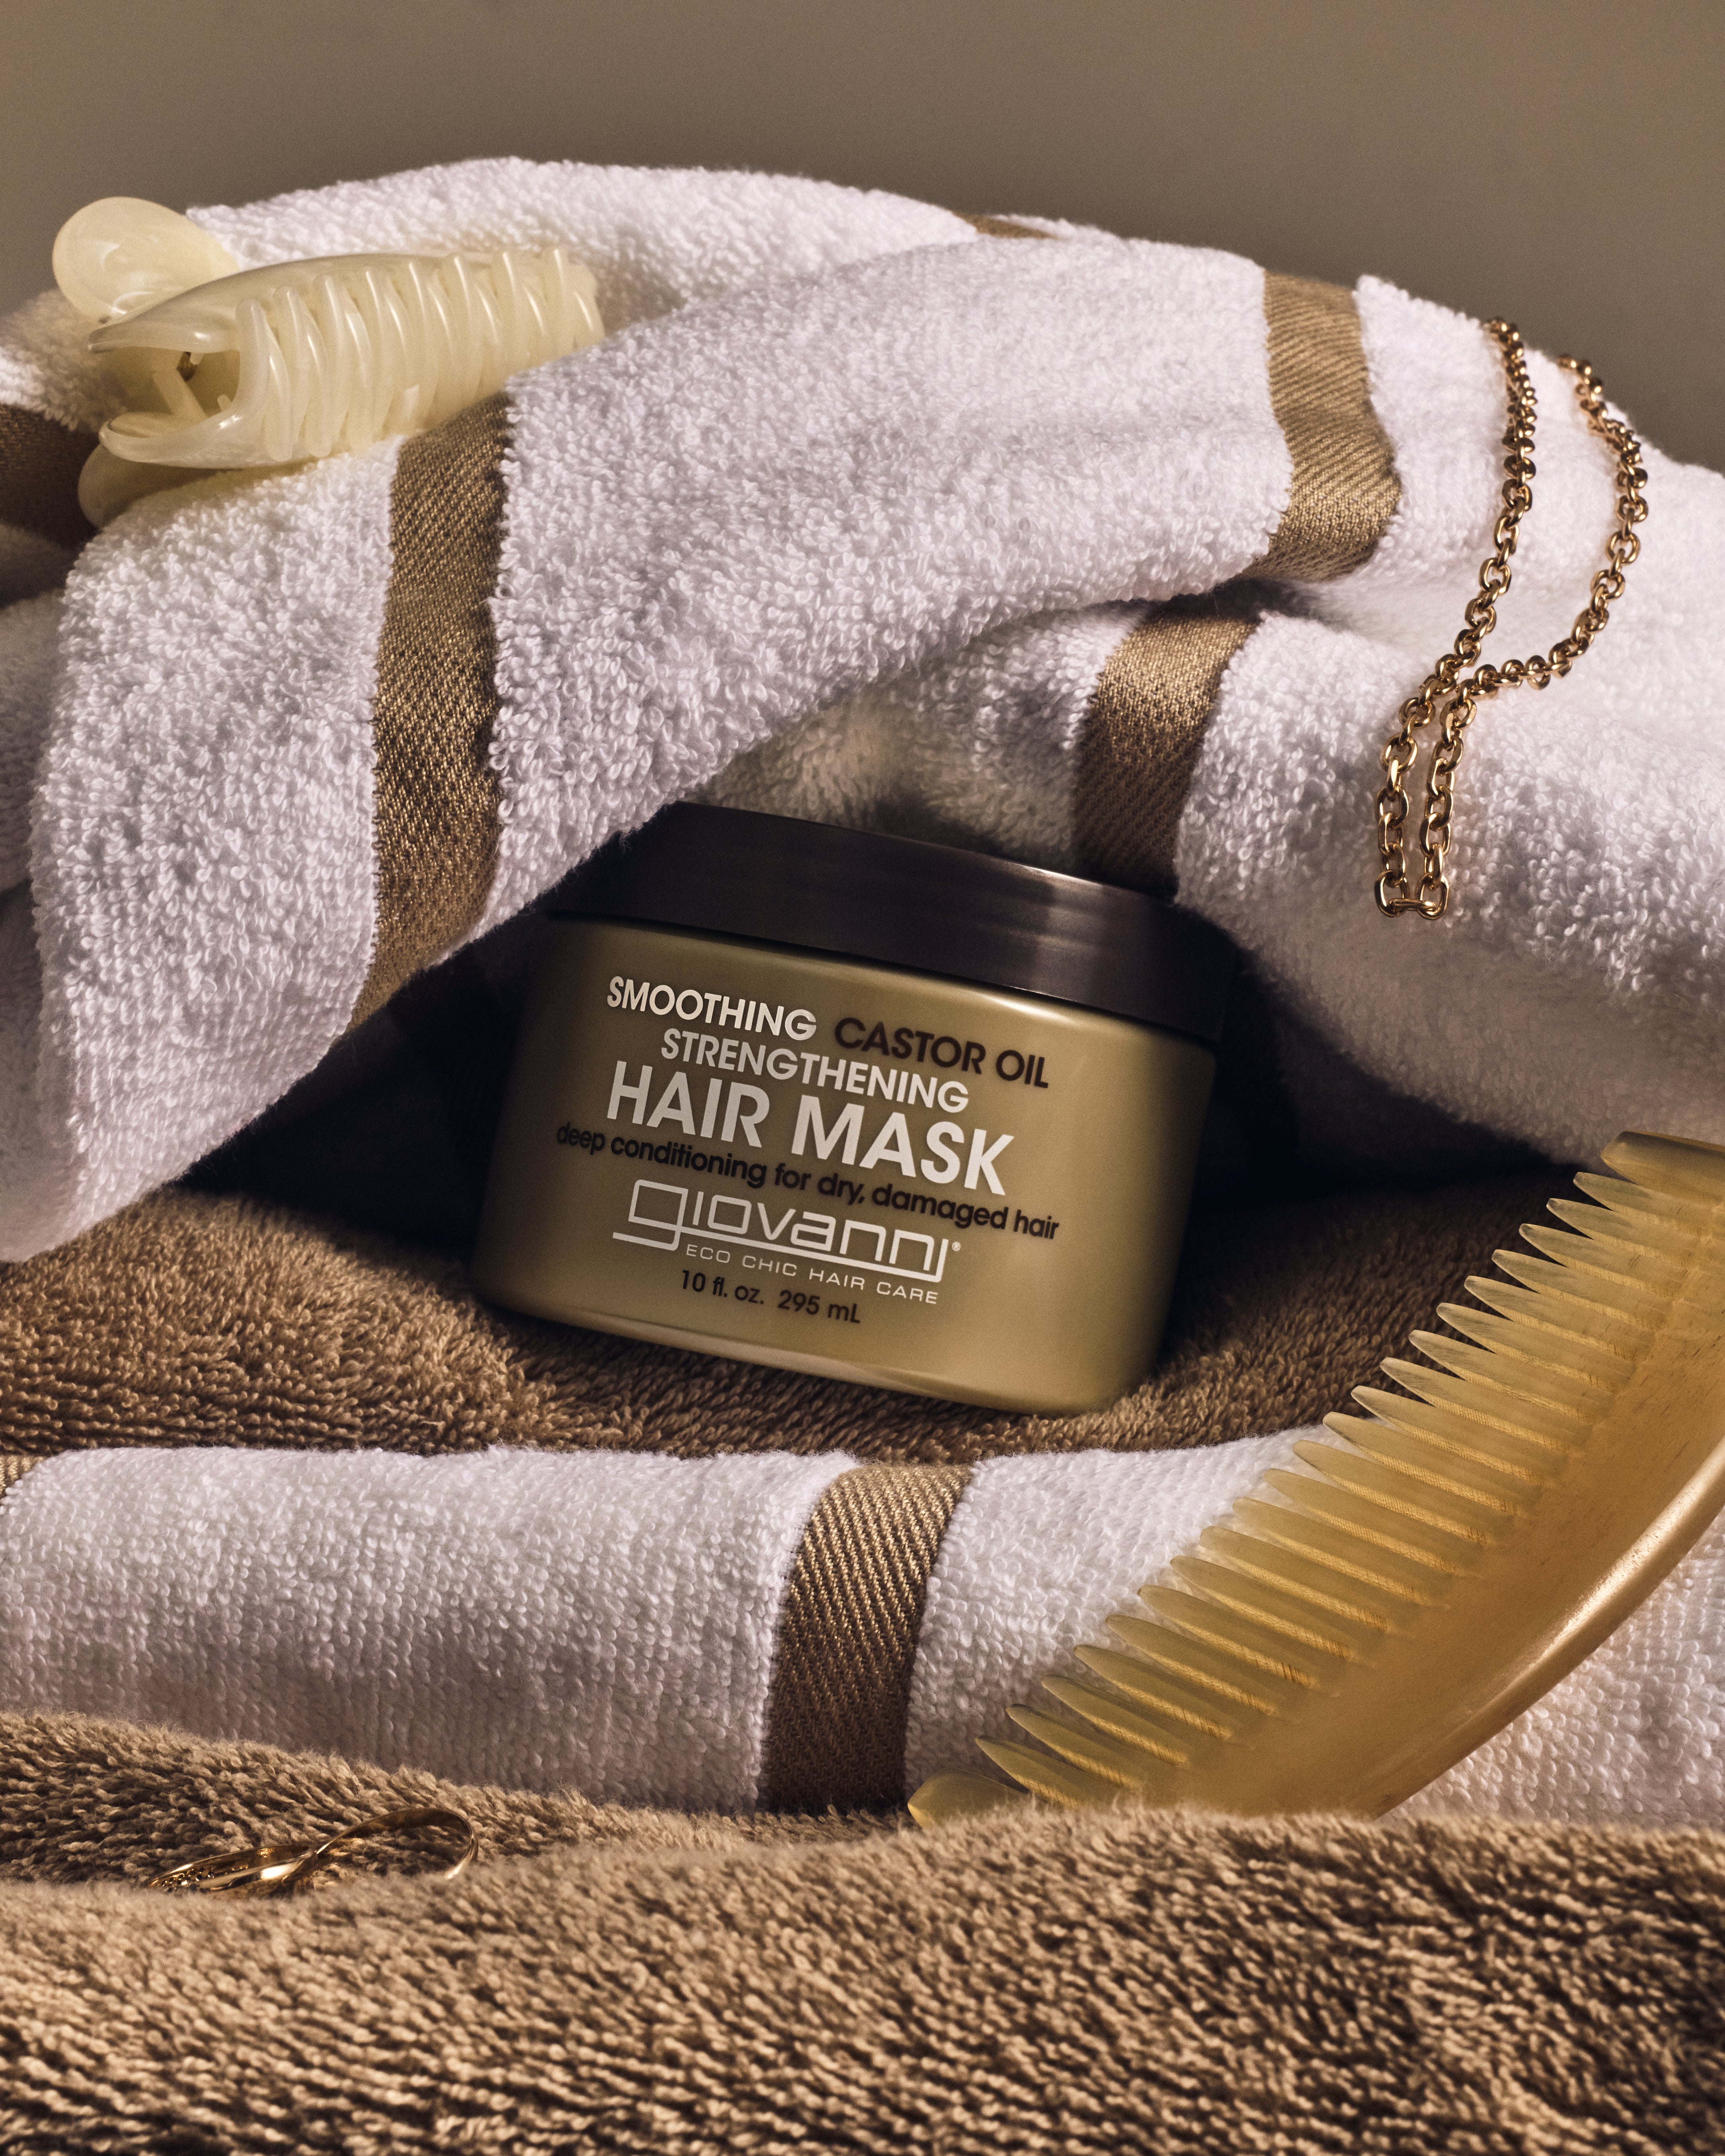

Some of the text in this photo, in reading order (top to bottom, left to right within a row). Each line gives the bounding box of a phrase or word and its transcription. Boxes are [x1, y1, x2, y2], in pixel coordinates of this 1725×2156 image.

[607, 976, 1049, 1088] SMOOTHING CASTOR OIL
[661, 1027, 969, 1113] STRENGTHENING
[607, 1060, 1015, 1196] HAIR MASK
[556, 1122, 1059, 1240] deep conditioning for dry, damaged hair
[681, 1269, 861, 1324] 10 fl. oz. 295 mL
[686, 1244, 938, 1304] ECO CHIC HAIR CARE
